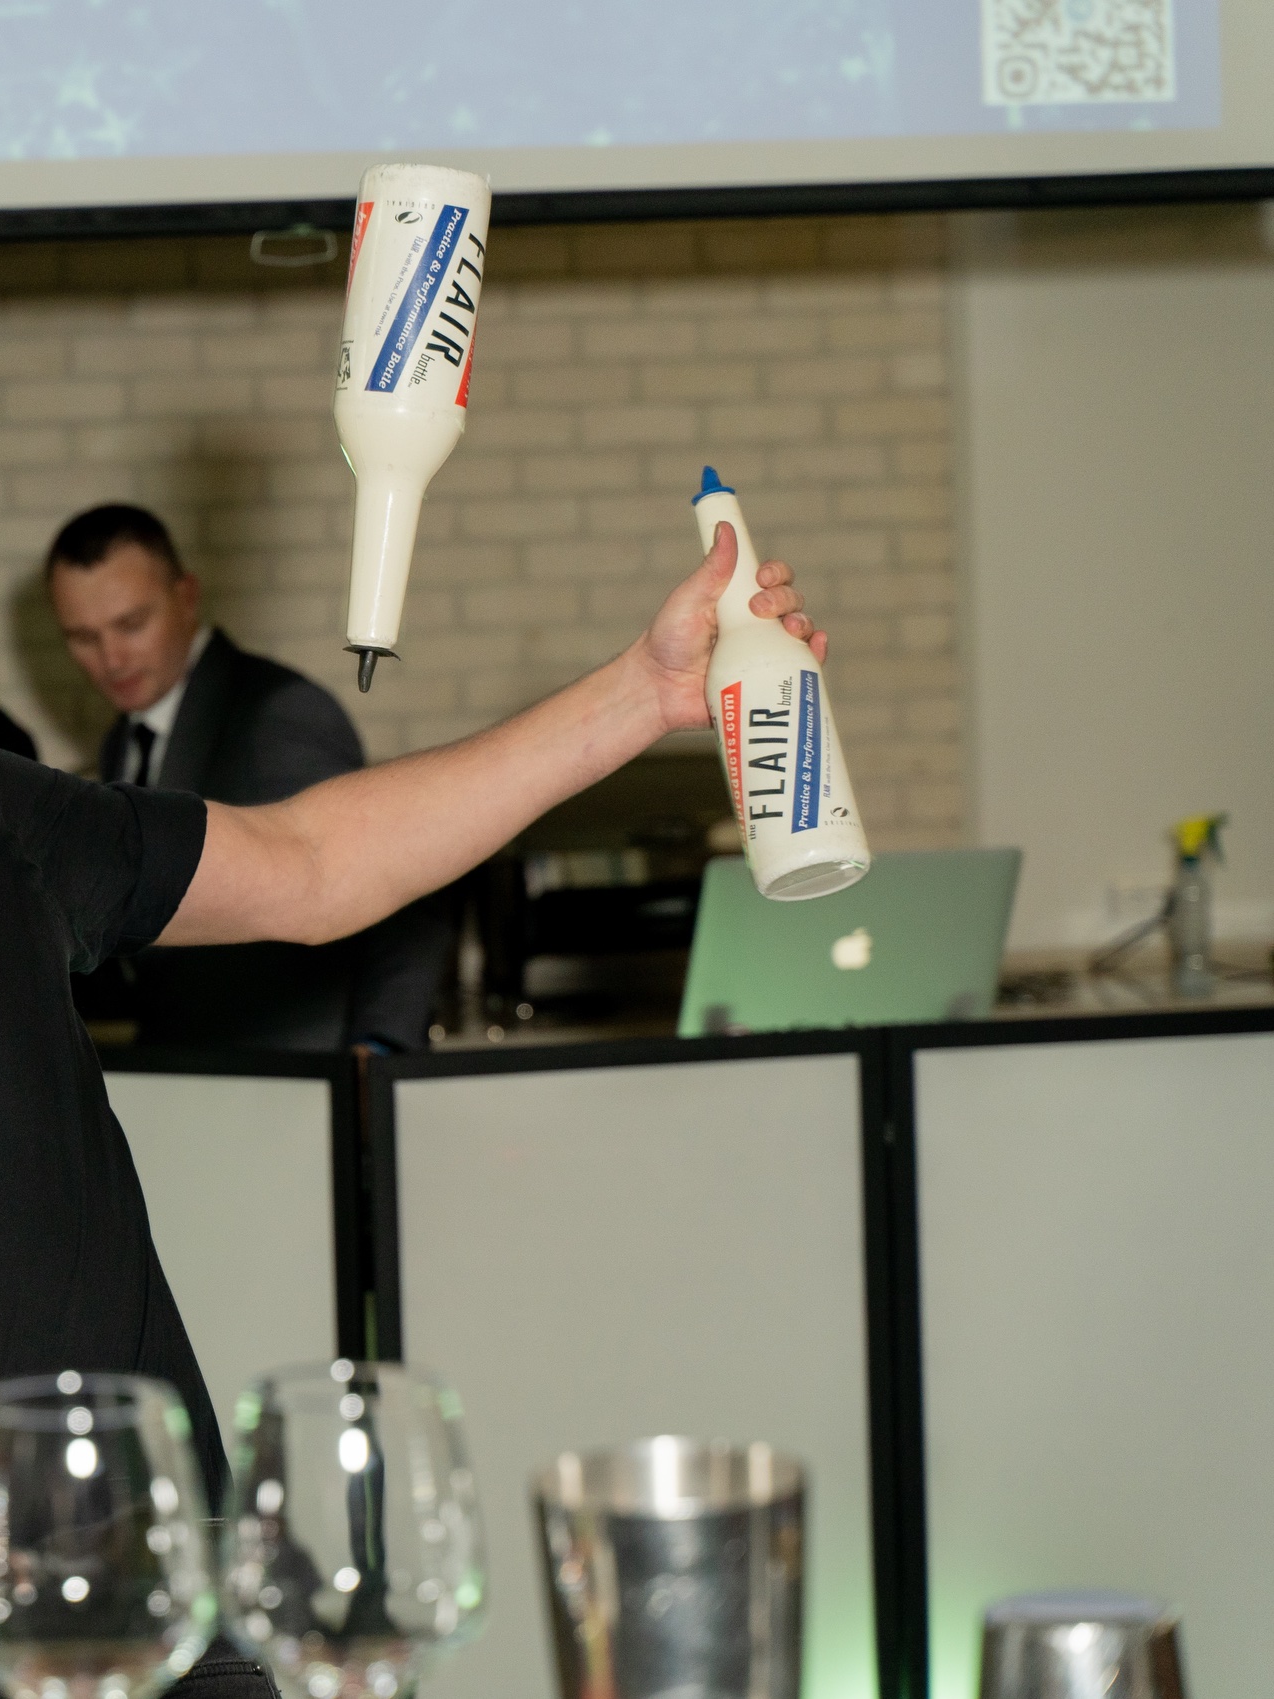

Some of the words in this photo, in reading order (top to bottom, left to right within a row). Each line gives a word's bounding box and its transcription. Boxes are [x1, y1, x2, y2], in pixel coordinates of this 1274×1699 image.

[436, 208, 462, 259] Practice
[401, 266, 409, 277] the
[405, 253, 414, 267] with
[430, 260, 441, 272] &
[395, 274, 436, 351] Performance
[425, 232, 485, 368] FLAIR
[379, 351, 401, 389] Bottle
[805, 673, 814, 703] Bottle
[802, 704, 814, 769] Performance
[748, 708, 790, 821] FLAIR
[801, 771, 812, 782] &
[798, 784, 811, 828] Practice
[748, 824, 757, 840] the
